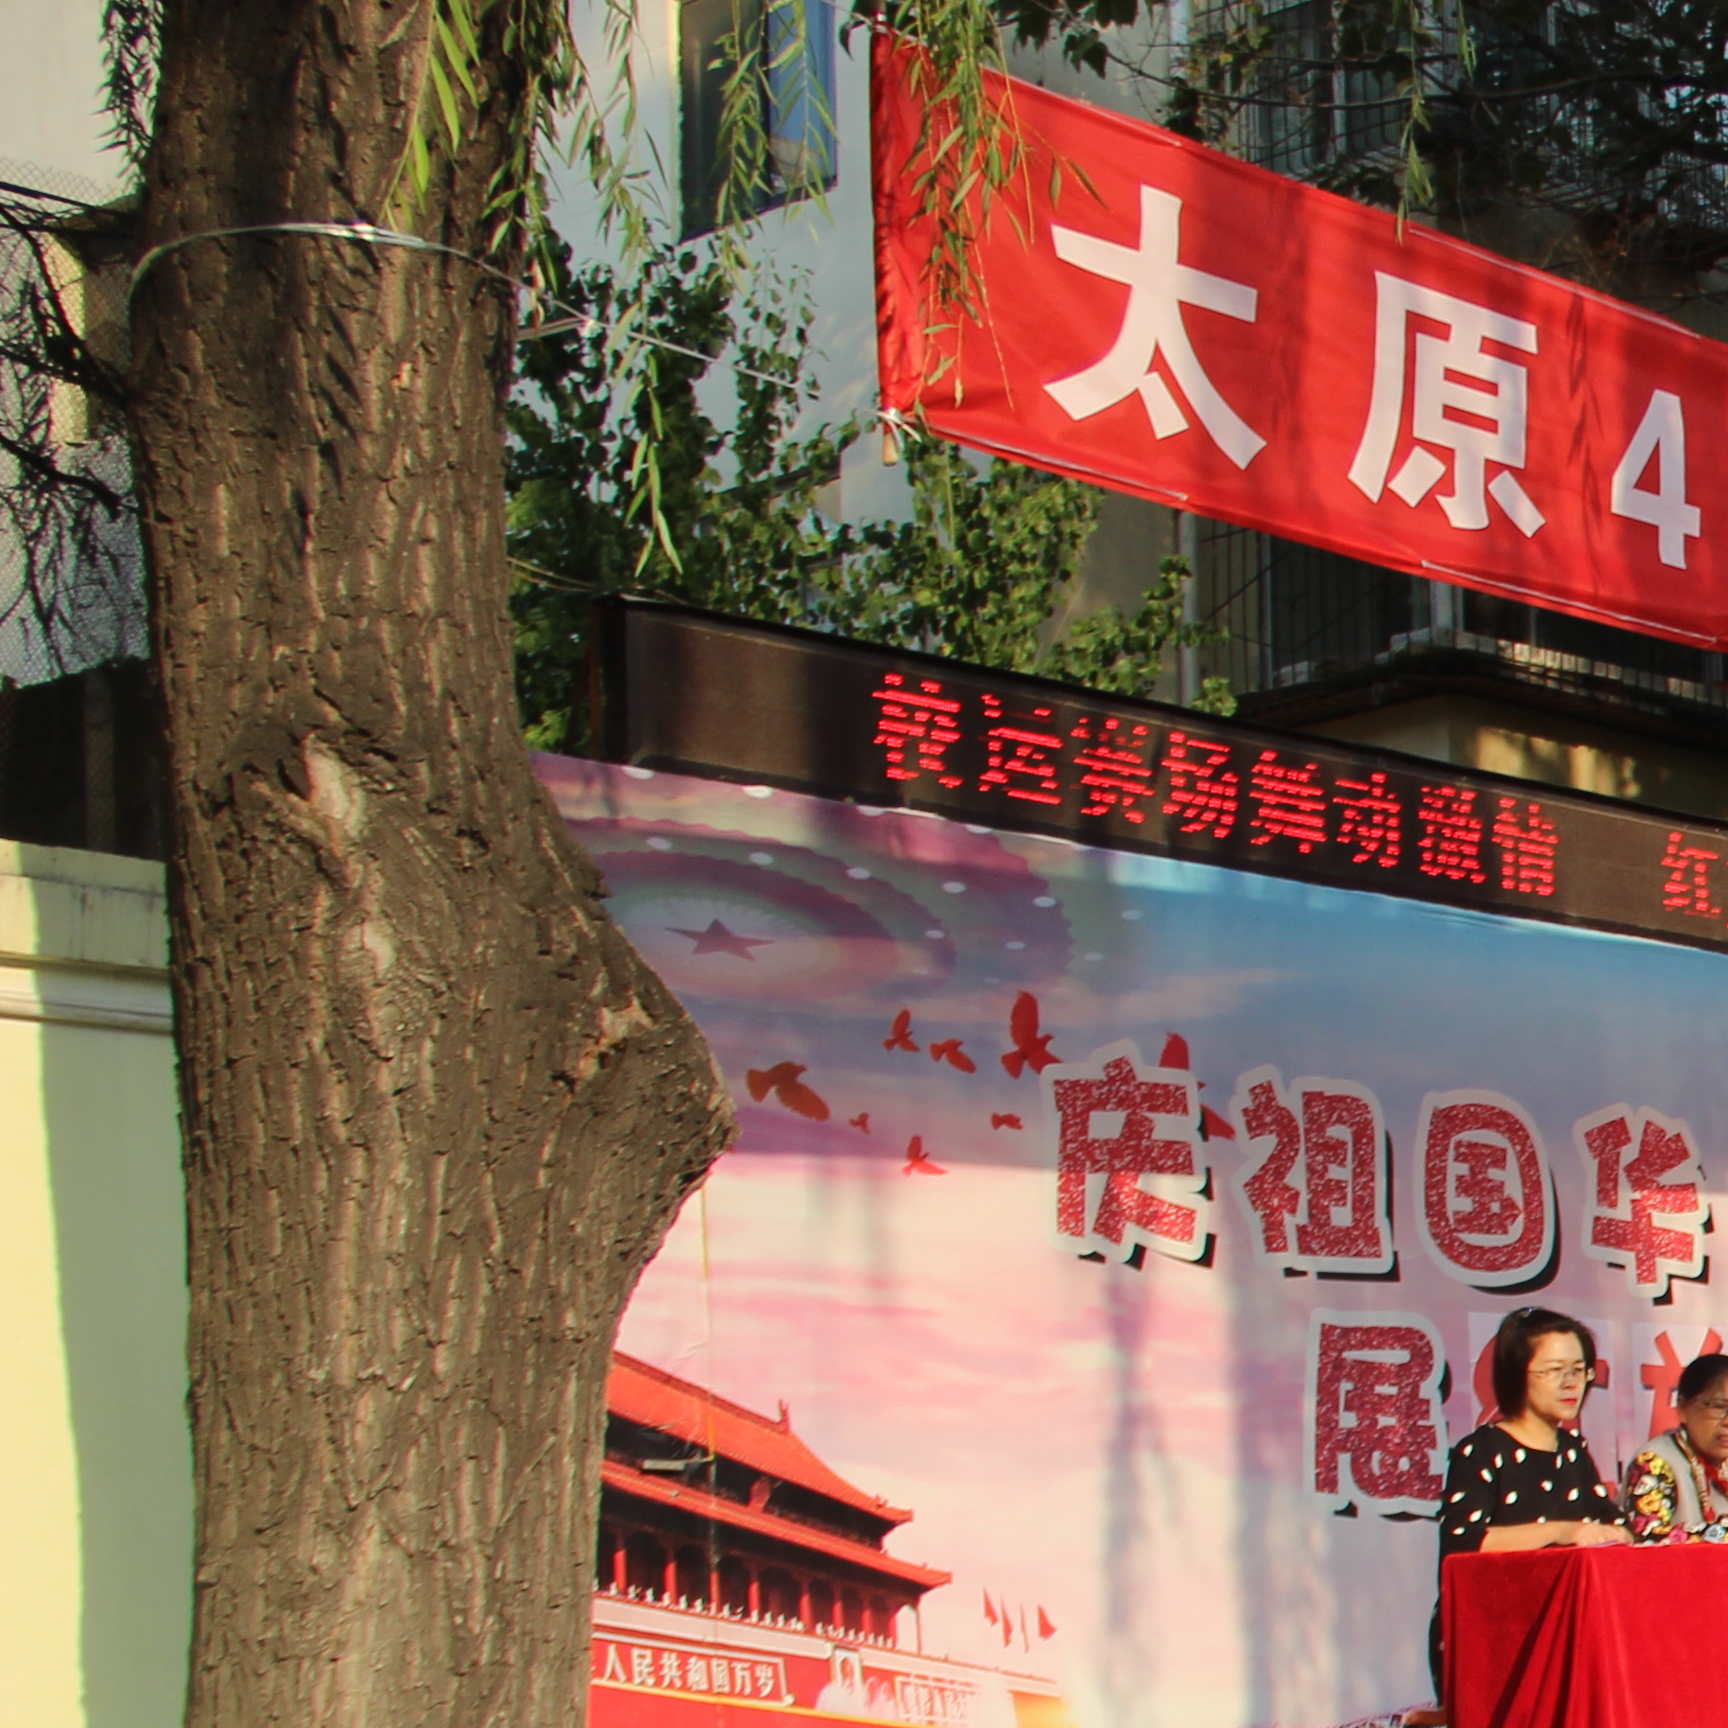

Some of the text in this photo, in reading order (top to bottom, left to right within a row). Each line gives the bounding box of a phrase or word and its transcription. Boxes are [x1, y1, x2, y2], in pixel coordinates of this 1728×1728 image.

[591, 1643, 776, 1698] 人民共和国万岁
